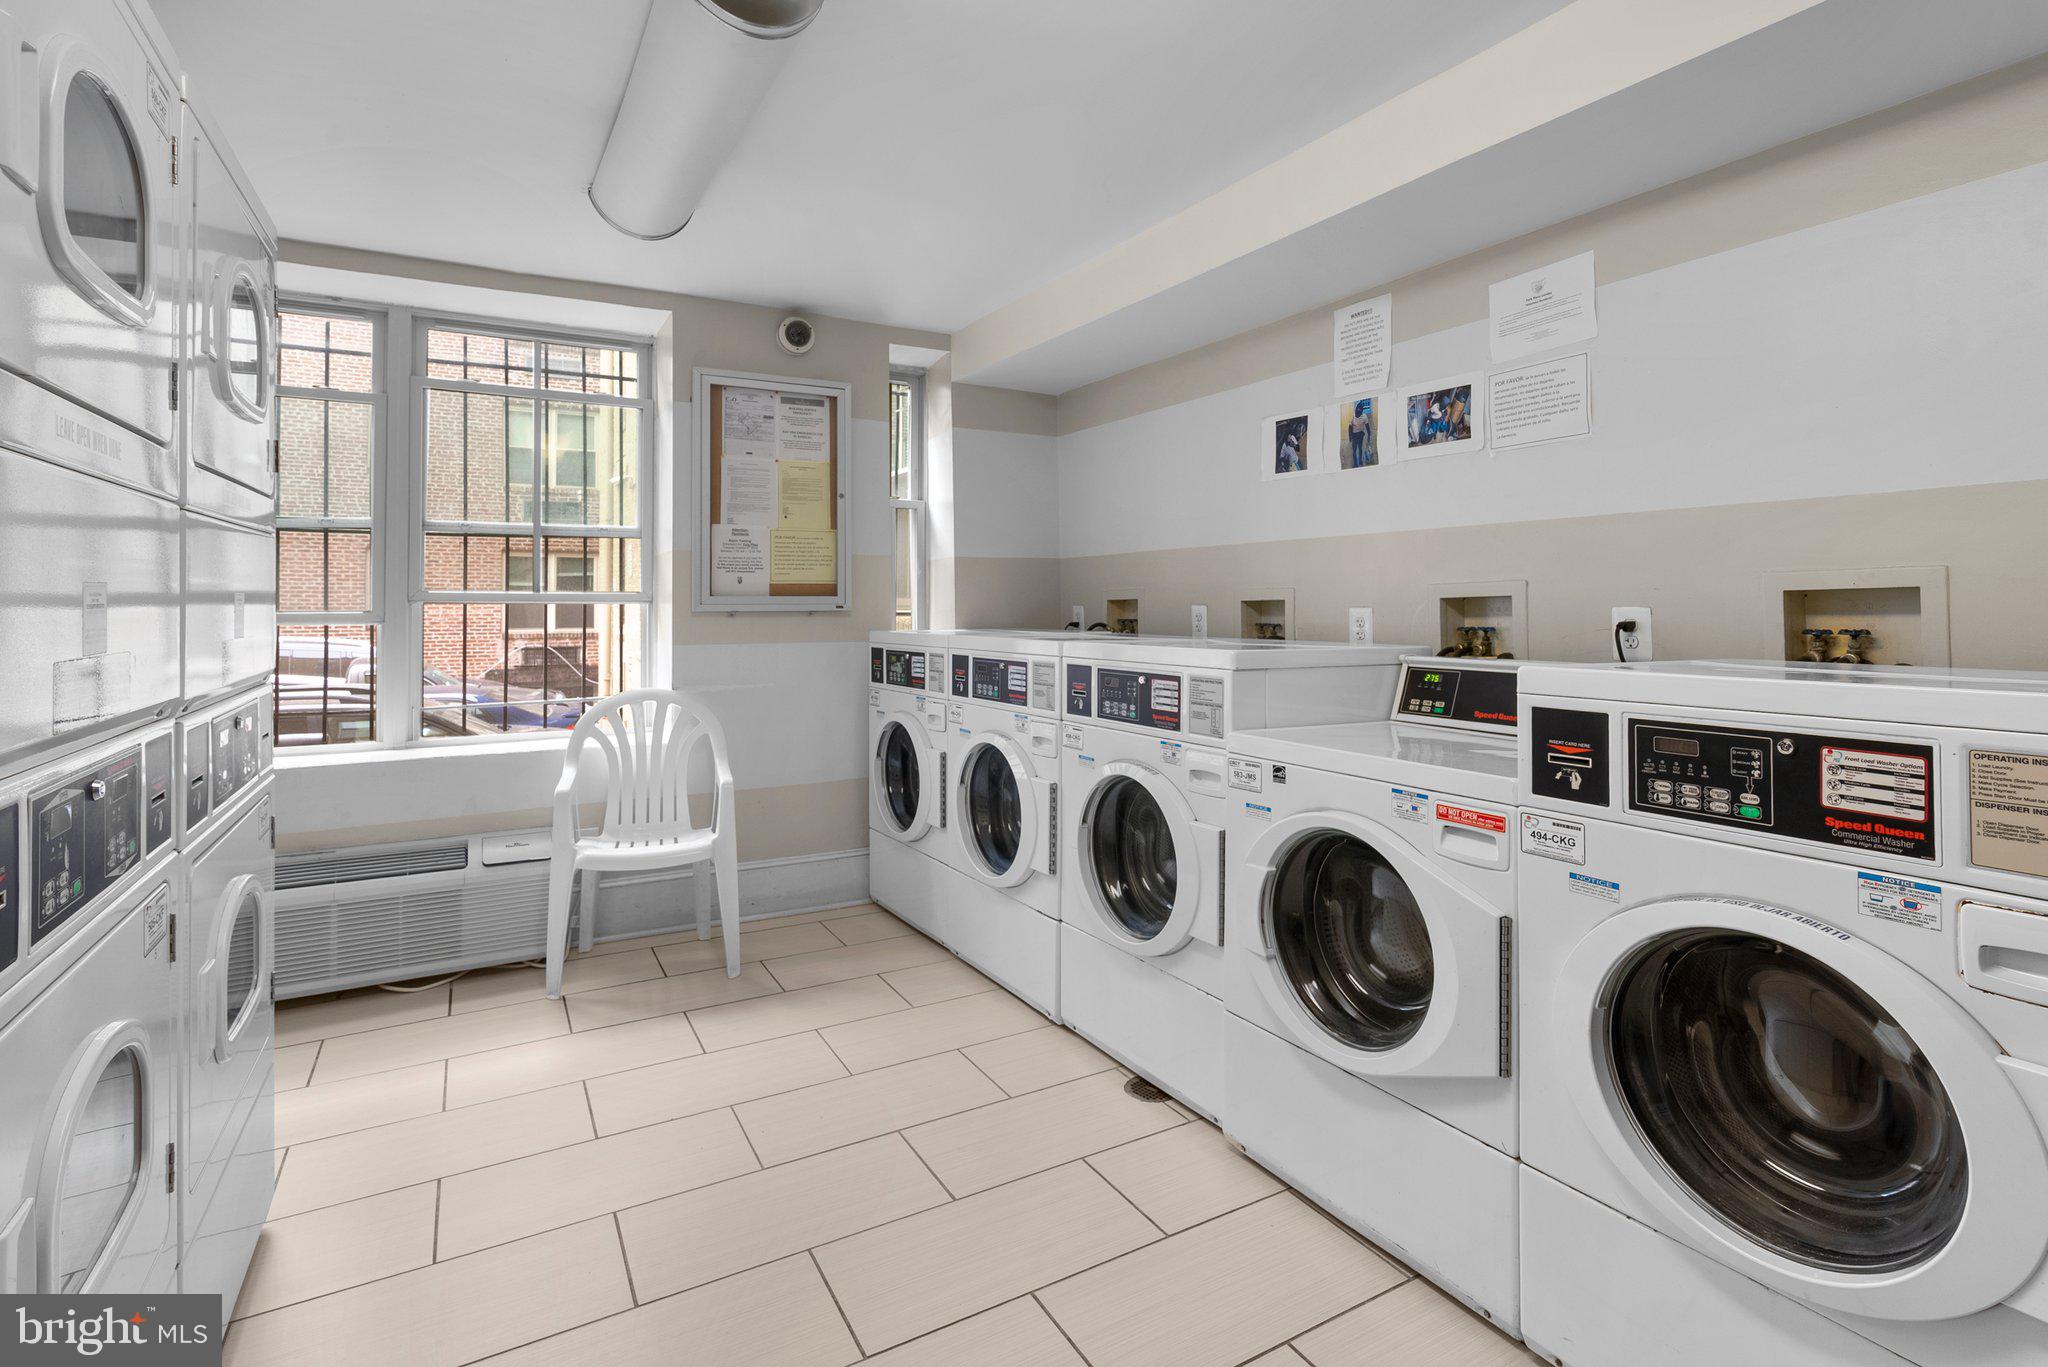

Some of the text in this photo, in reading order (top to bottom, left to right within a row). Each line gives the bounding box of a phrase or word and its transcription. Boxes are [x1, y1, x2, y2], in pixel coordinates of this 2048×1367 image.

[56, 414, 75, 443] LEAVE
[76, 423, 91, 448] OPEN
[1474, 710, 1498, 719] Speed
[1974, 753, 2029, 764] OPERATING
[1975, 801, 2030, 813] DISPENSER
[1448, 808, 1460, 816] NOT
[1461, 811, 1477, 820] OPEN
[1825, 816, 1925, 840] Speed Queen
[1530, 830, 1576, 847] 494-CKG
[1832, 828, 1914, 848] Commercial Washer
[1873, 844, 1903, 853] Efficiency
[1576, 875, 1612, 887] NOTICE
[1882, 877, 1915, 887] NOTICE
[1750, 904, 1792, 917] DEJAR
[1792, 915, 1851, 940] ABIERTO
